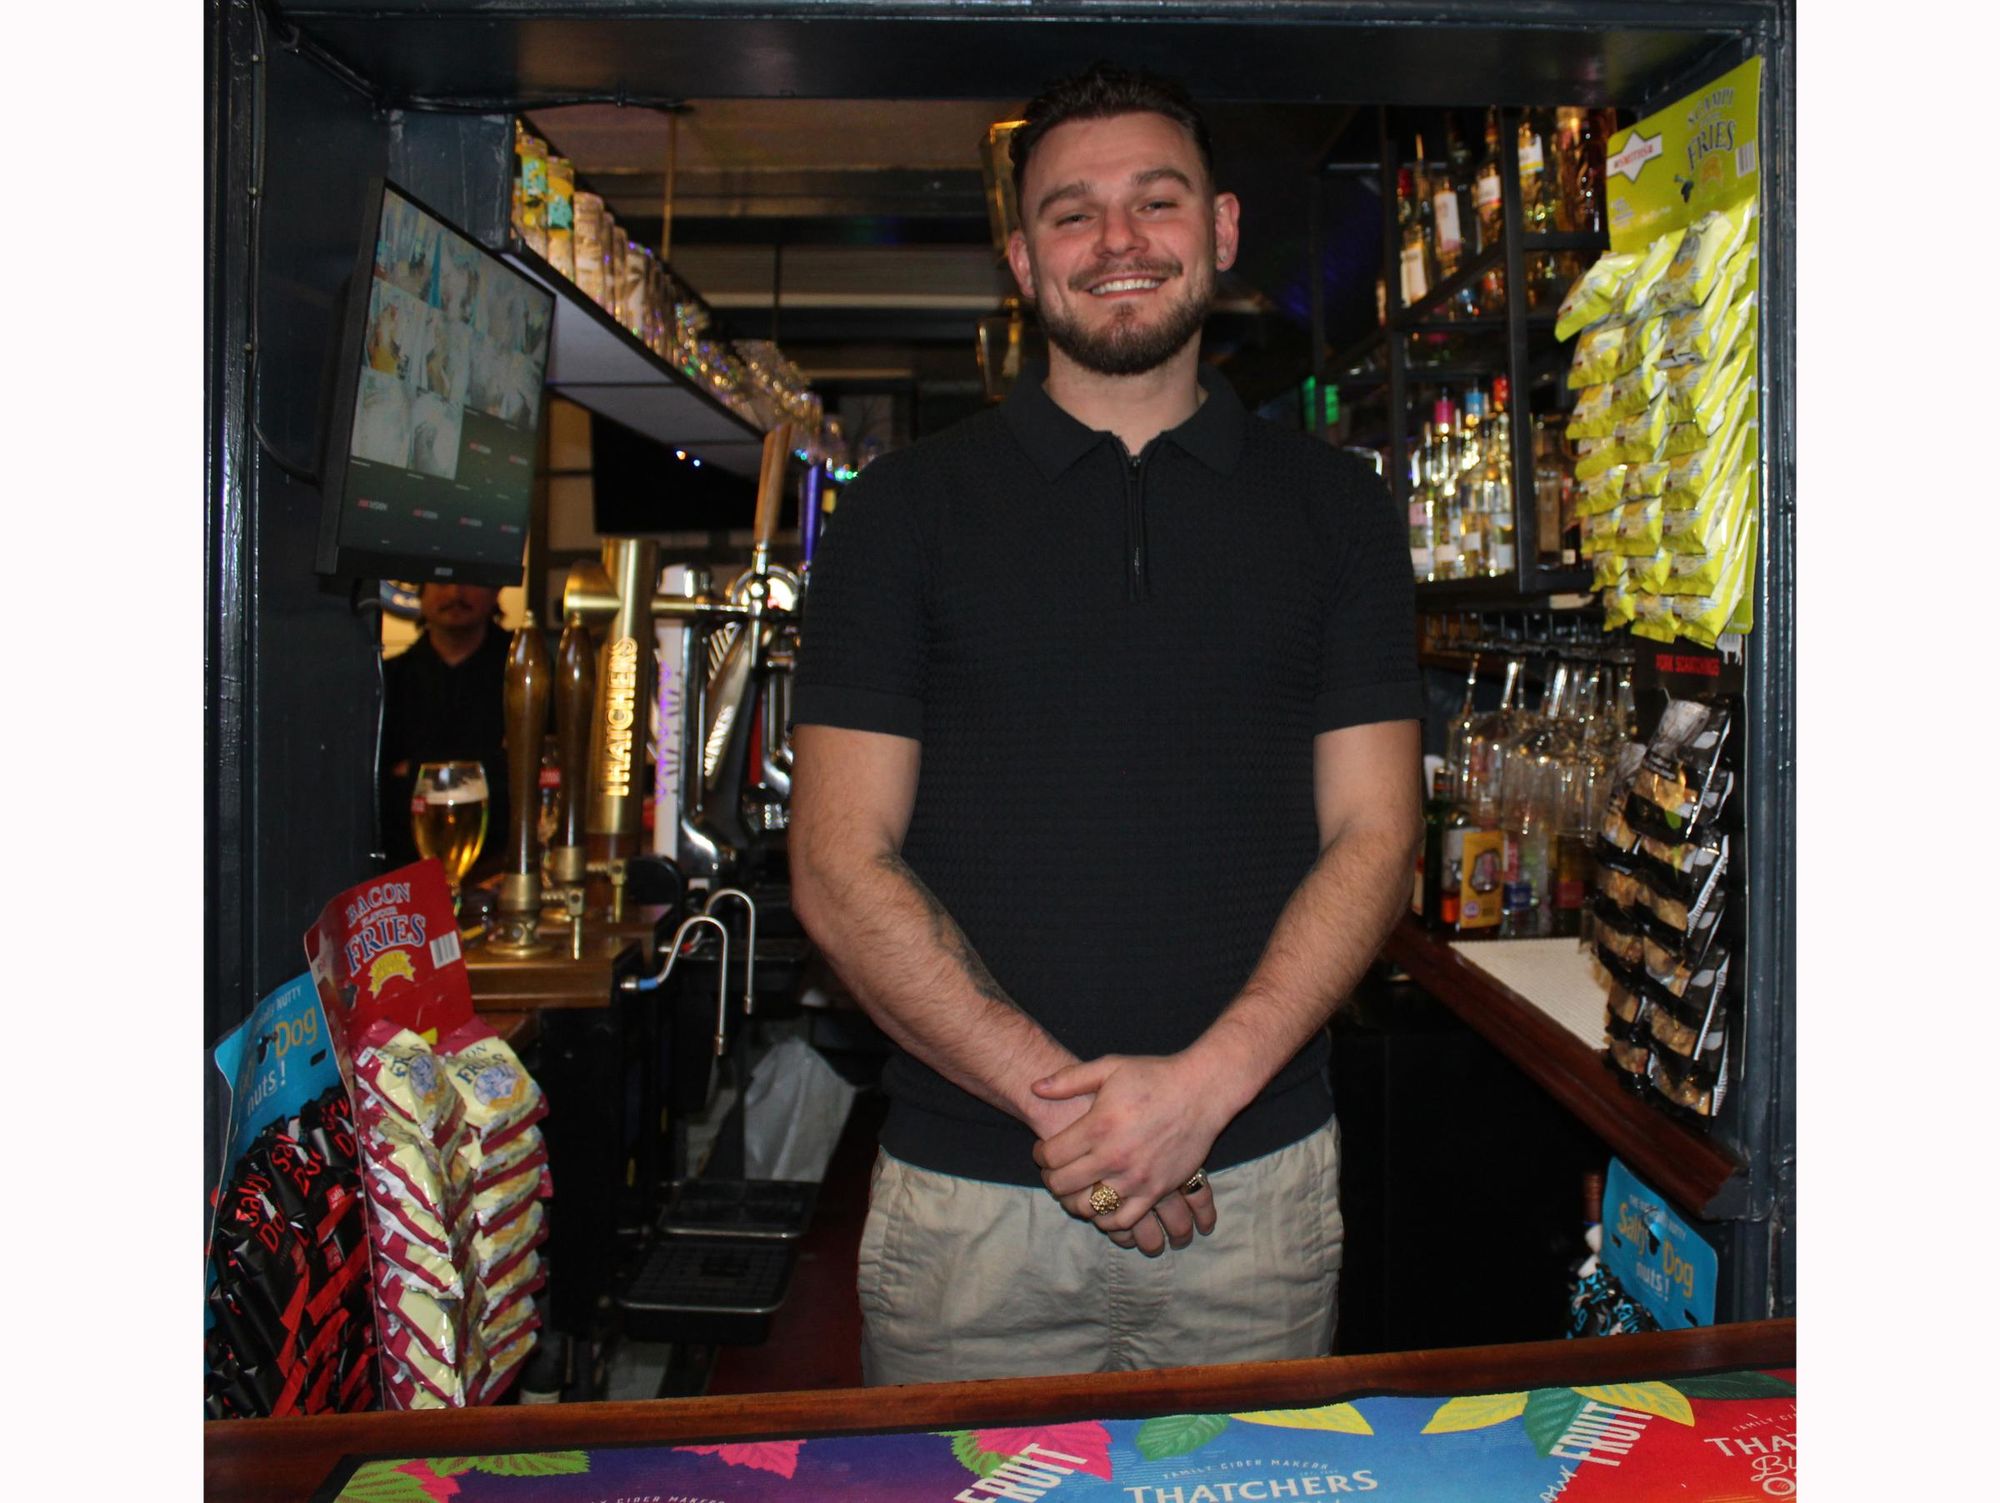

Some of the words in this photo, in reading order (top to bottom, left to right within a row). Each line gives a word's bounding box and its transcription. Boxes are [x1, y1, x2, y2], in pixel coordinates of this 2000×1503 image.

[1686, 120, 1735, 173] FRIES
[345, 882, 411, 928] BACON
[345, 913, 426, 978] FRIES
[275, 1006, 318, 1057] Dog
[1662, 1239, 1695, 1299] Dog
[1549, 1401, 1653, 1467] FRUIT
[953, 1442, 1089, 1503] FRUIT
[1123, 1469, 1379, 1503] THATCHERS
[1220, 1458, 1263, 1471] CIDER
